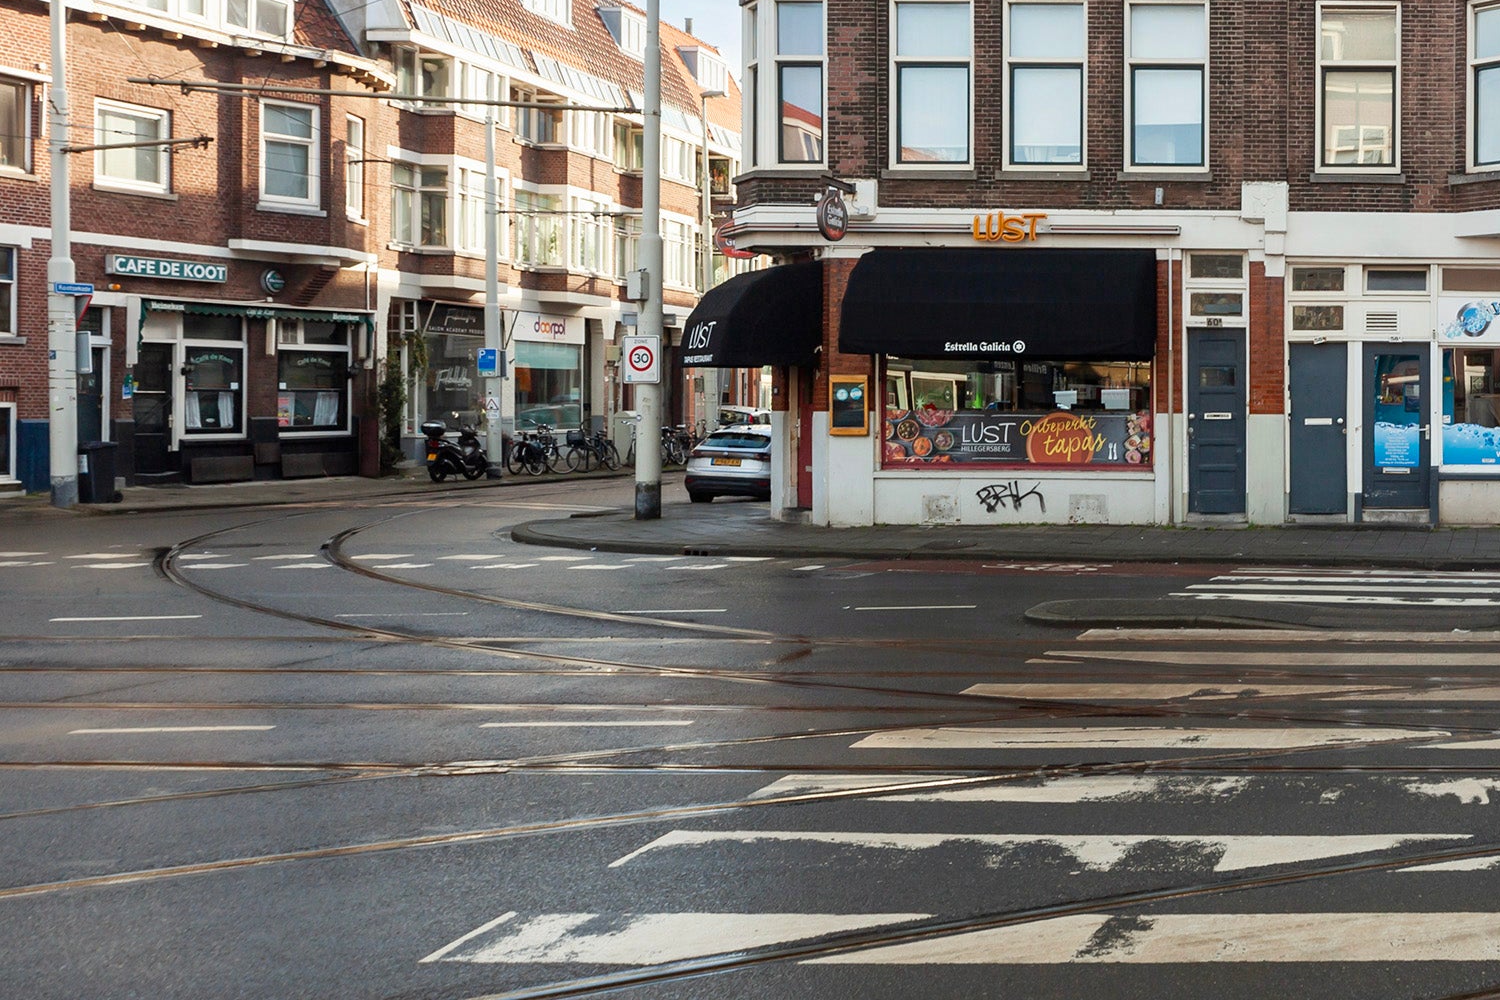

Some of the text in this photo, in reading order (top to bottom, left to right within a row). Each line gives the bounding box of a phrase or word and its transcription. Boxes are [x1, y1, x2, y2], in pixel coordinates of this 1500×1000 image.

[973, 211, 1048, 242] LUST
[115, 257, 227, 280] CAFE DE KOOT
[688, 321, 717, 350] LUST
[944, 341, 1011, 352] Estrella Galicia
[633, 353, 649, 364] 30
[961, 422, 1016, 444] LUST
[1020, 414, 1097, 436] Onbeperkt
[960, 445, 1011, 453] HILLEGERSBERG
[1043, 433, 1108, 462] tapas
